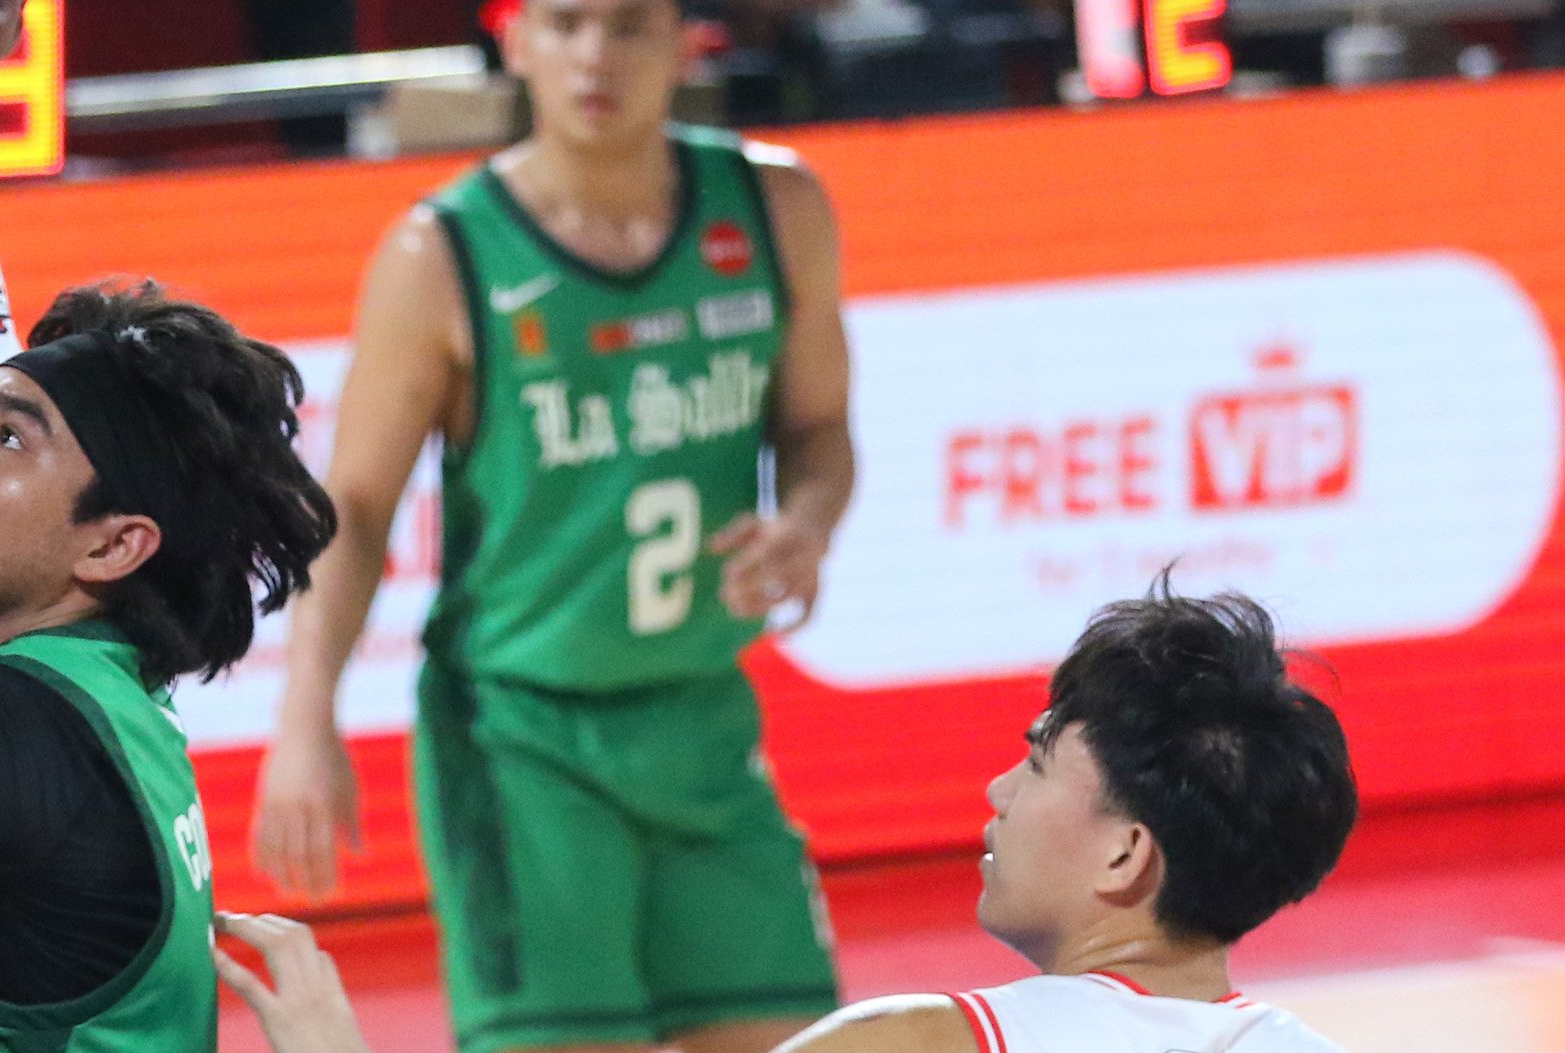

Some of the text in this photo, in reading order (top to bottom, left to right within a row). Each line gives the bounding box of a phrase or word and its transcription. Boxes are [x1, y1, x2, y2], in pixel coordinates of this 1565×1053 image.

[943, 388, 1355, 533] FREE VIP
[624, 477, 701, 635] 2
